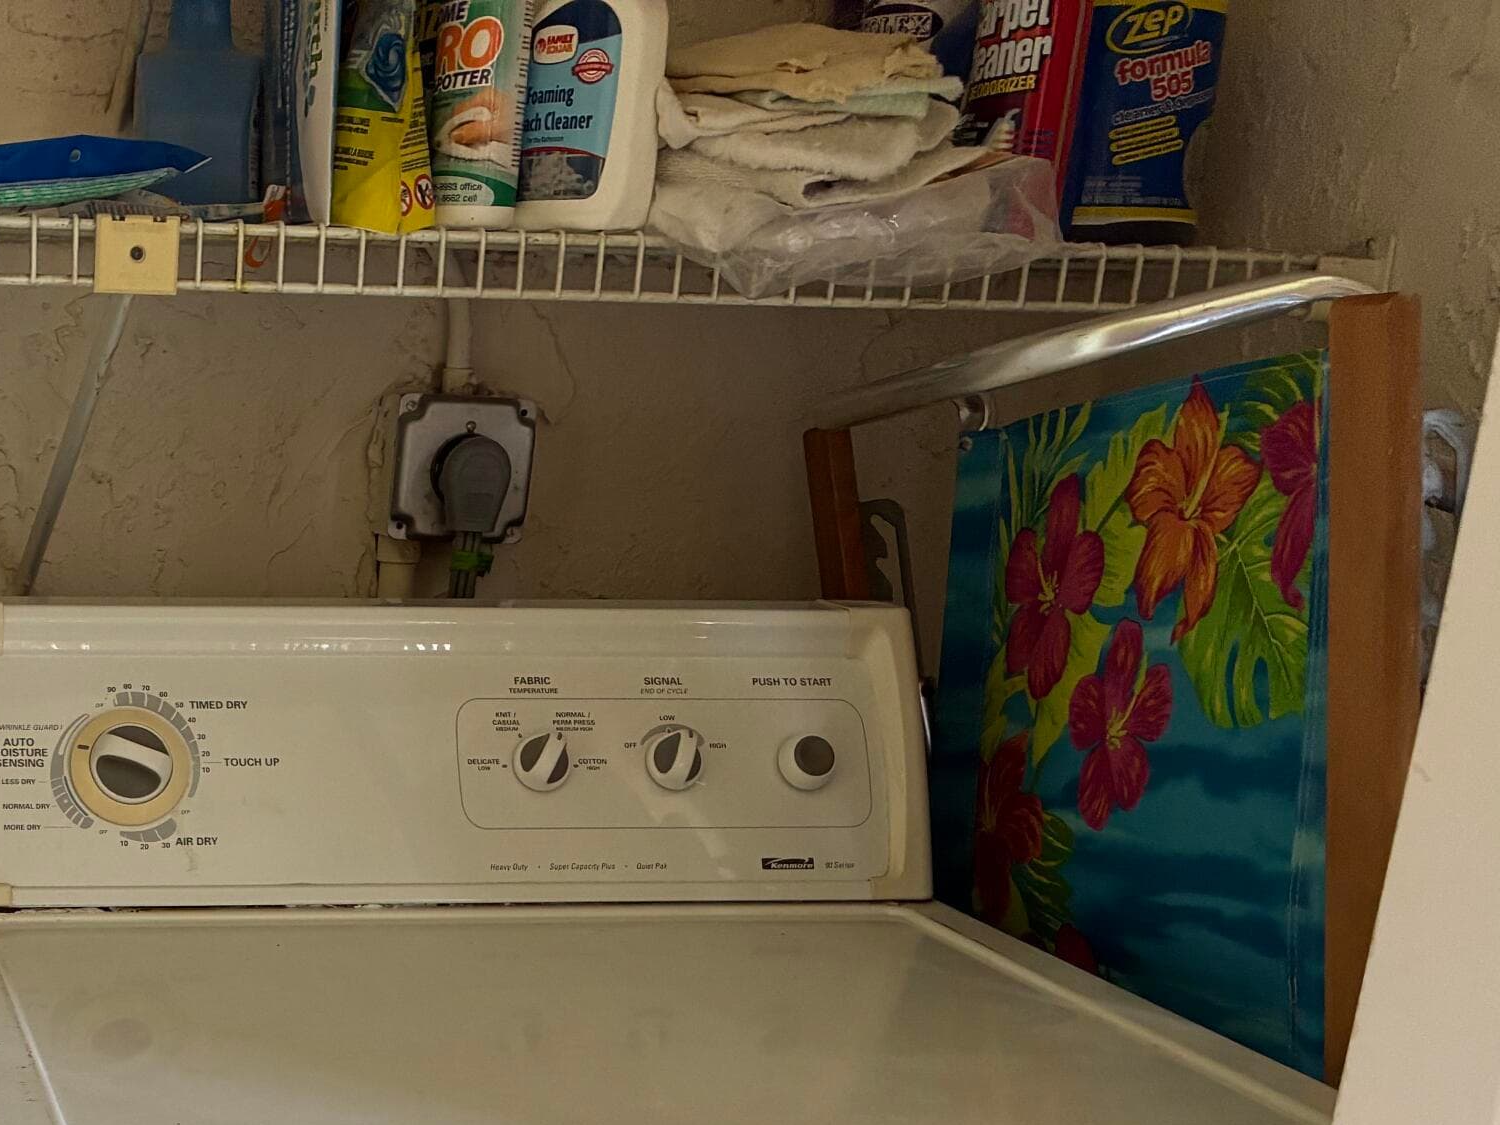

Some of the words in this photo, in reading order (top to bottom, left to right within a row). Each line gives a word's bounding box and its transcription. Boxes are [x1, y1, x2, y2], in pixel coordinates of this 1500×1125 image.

[979, 0, 1049, 38] arpet
[973, 35, 1052, 82] eaner
[1115, 40, 1212, 85] formula
[968, 74, 1036, 100] EODORIZER
[1151, 70, 1193, 101] 505
[545, 112, 593, 130] Cleaner
[514, 677, 551, 685] FABRIC
[644, 677, 682, 685] SIGNAL
[752, 678, 780, 686] PUSH
[783, 678, 797, 686] TO
[800, 678, 832, 686] START
[189, 701, 223, 710] TIMED
[226, 701, 247, 710] DRY
[3, 738, 34, 746] AUTO
[224, 758, 262, 767] TOUCH
[264, 758, 280, 767] UP
[176, 837, 194, 845] AIR
[196, 837, 218, 845] DRY
[770, 861, 814, 869] Kenmore
